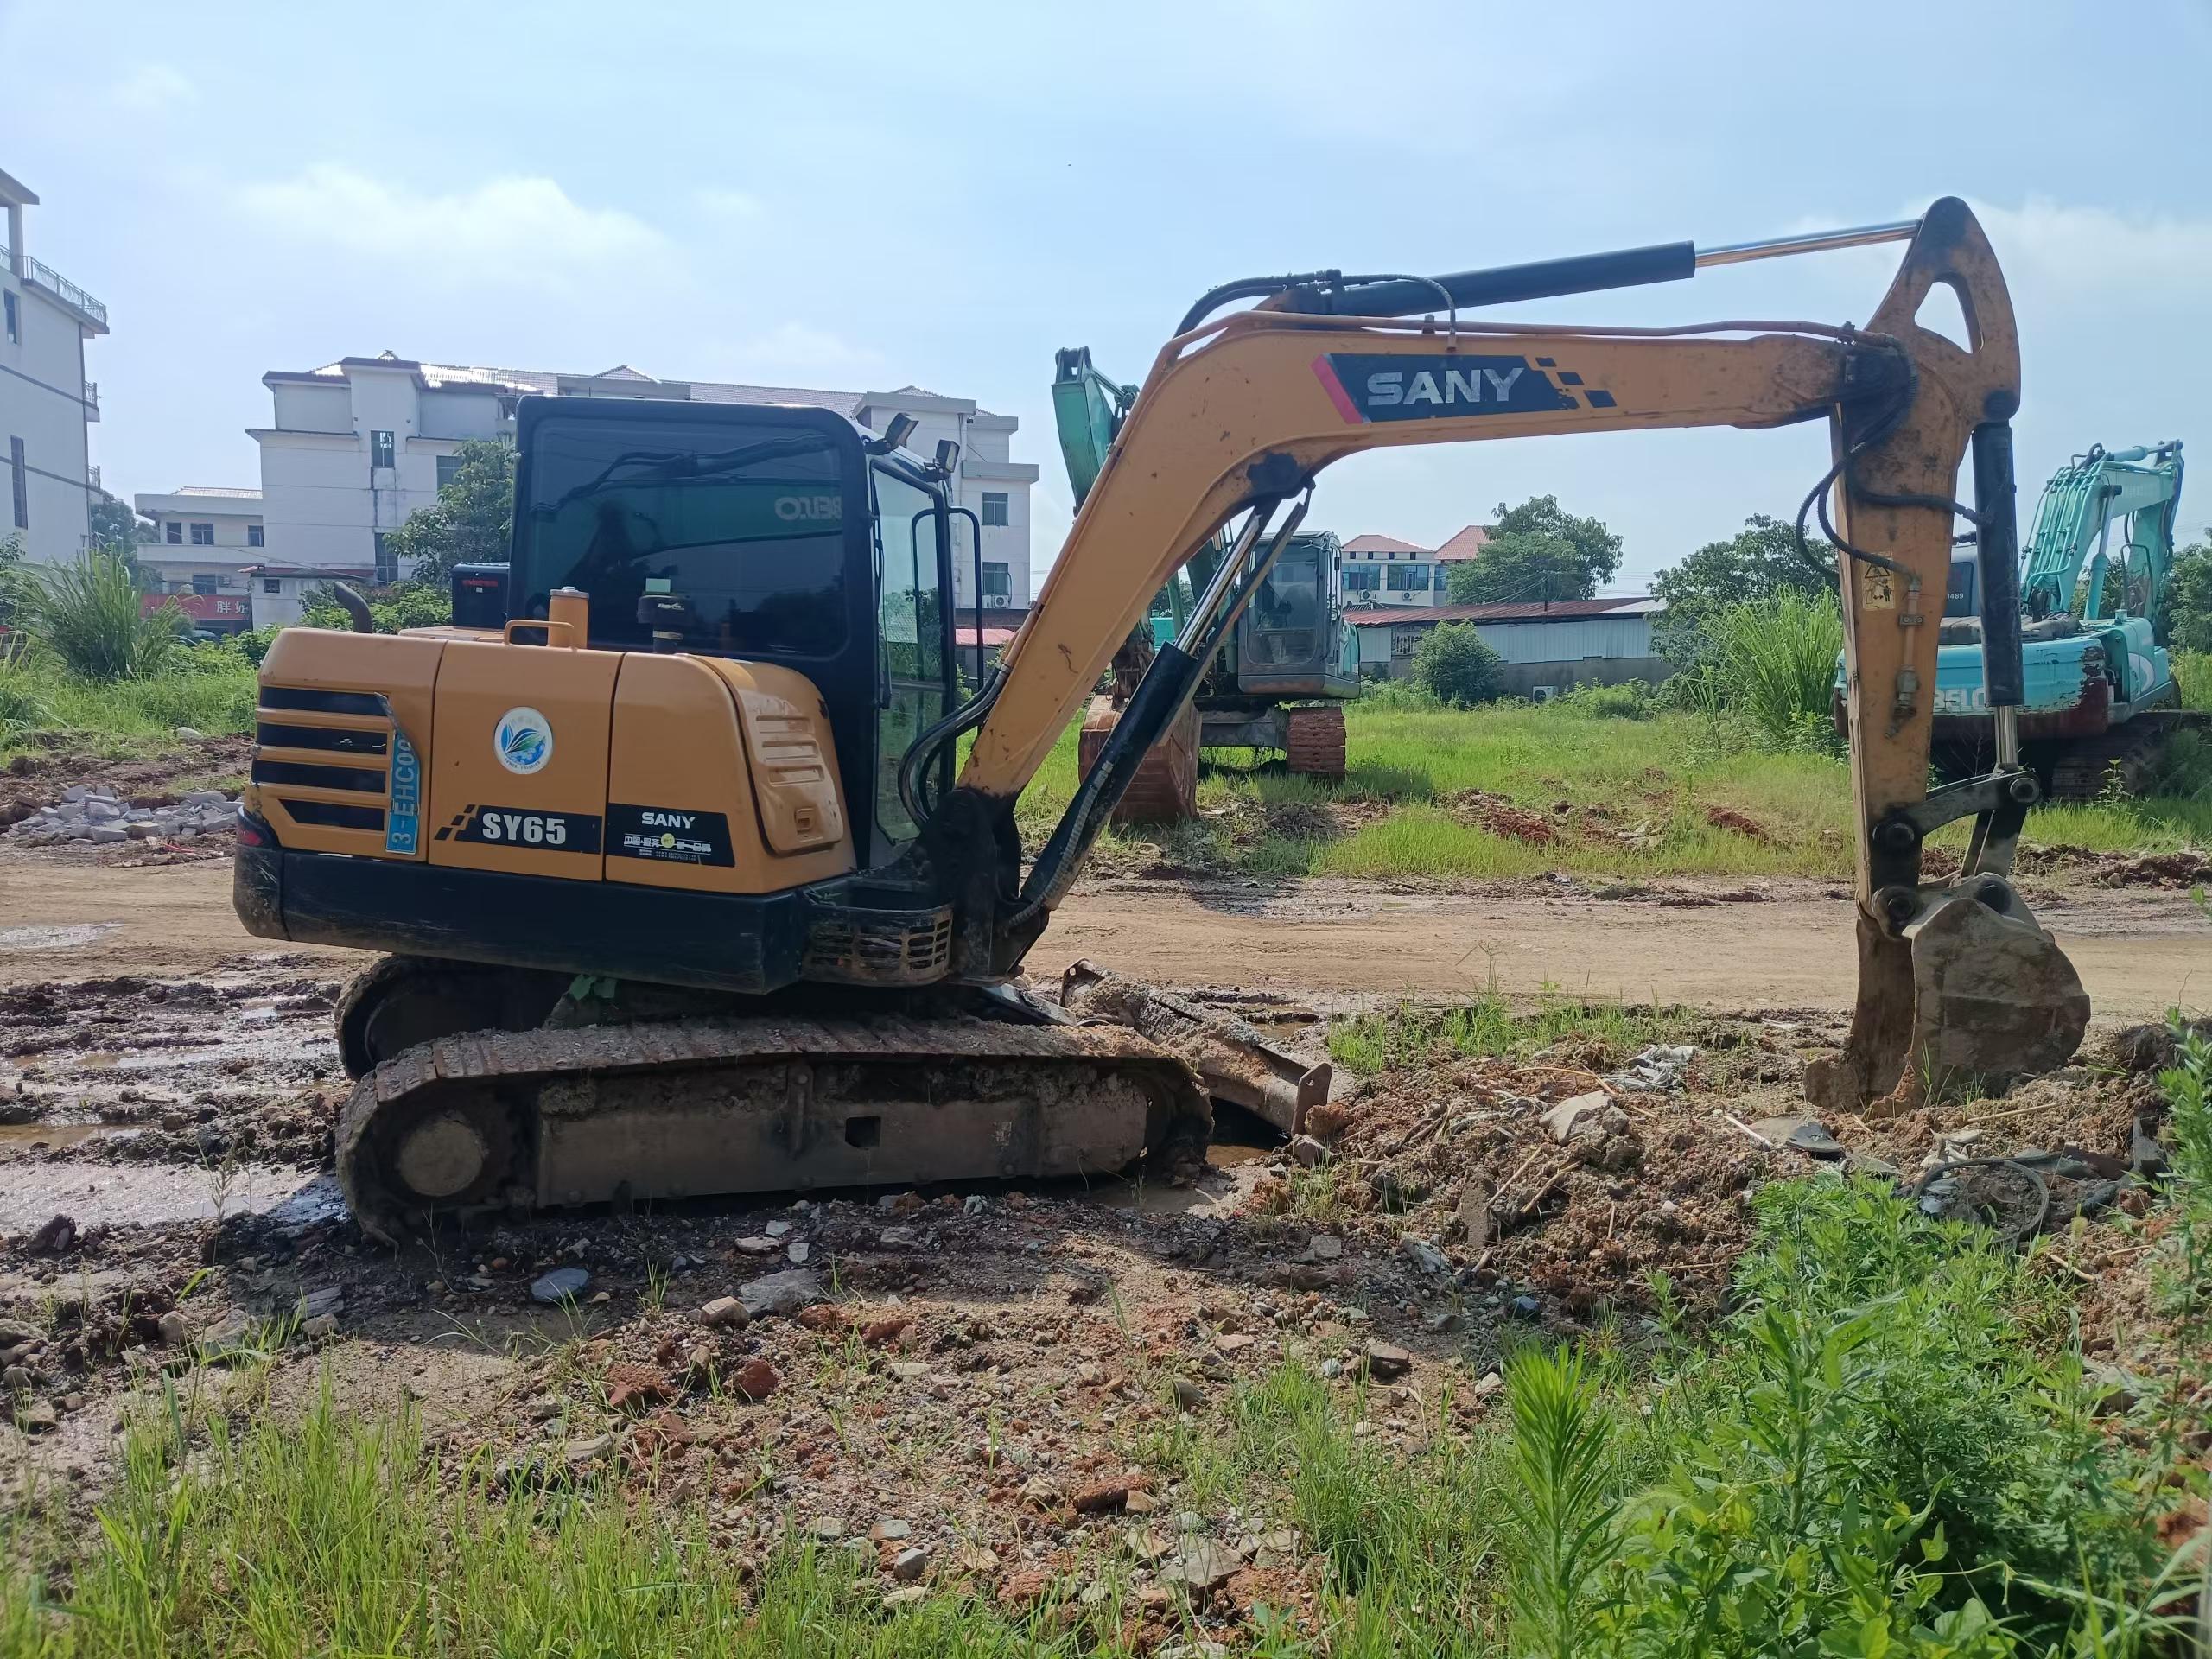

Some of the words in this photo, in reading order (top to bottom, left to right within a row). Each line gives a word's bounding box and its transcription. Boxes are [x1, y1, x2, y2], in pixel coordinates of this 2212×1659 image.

[1366, 367, 1525, 406] SANY
[481, 812, 567, 845] SY65
[641, 812, 696, 830] SANY
